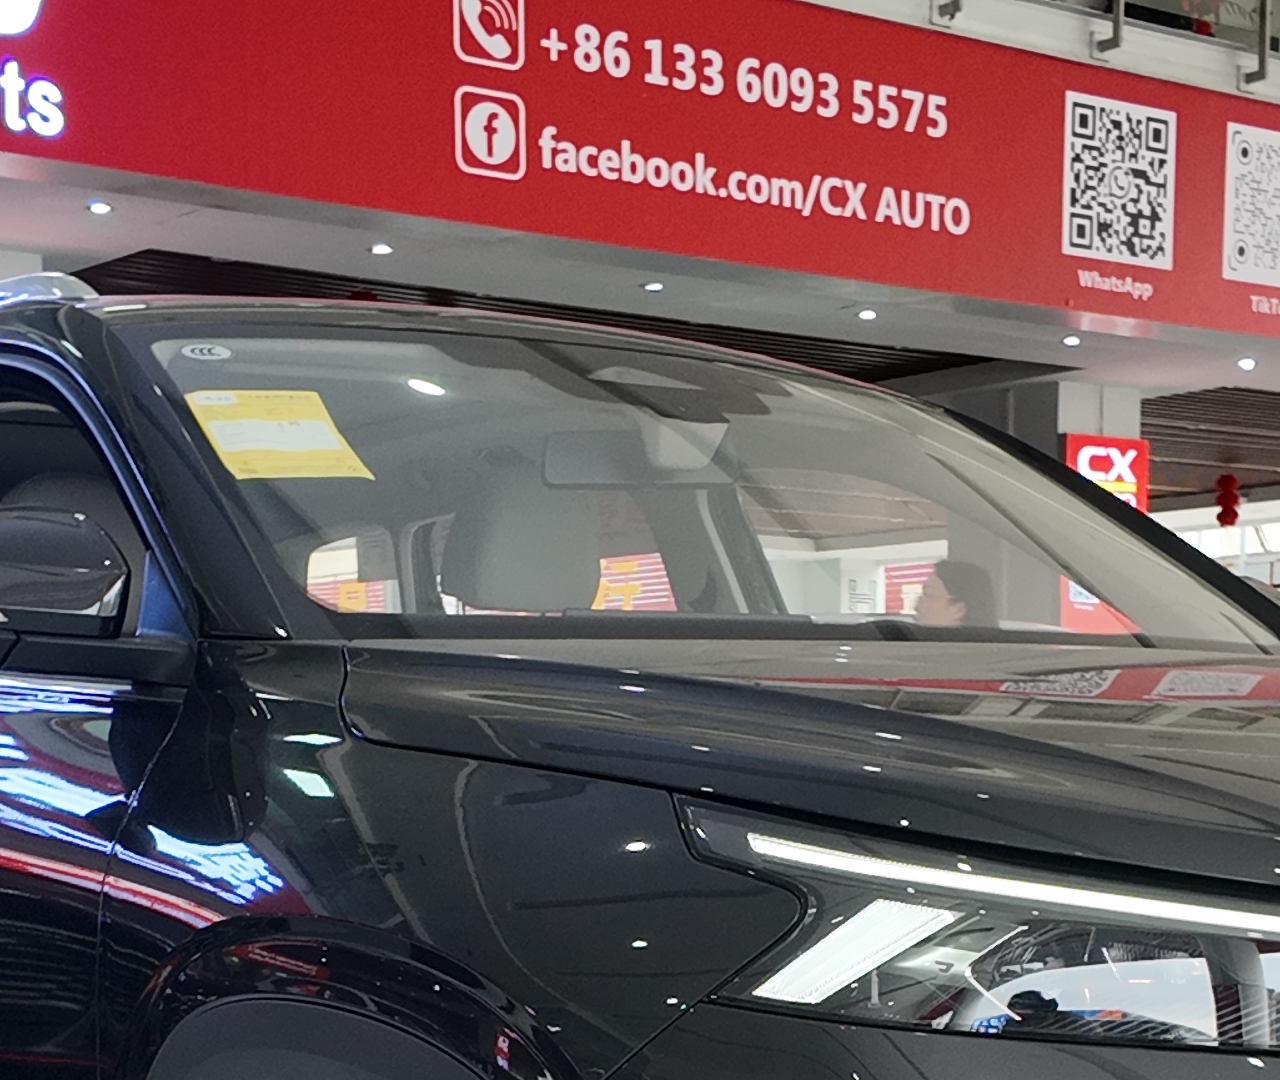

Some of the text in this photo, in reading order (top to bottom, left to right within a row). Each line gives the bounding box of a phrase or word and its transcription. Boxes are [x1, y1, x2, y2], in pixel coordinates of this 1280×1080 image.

[539, 23, 949, 139] +86 133 6093 5575
[538, 125, 971, 236] facebook.com/CX AUTO
[1076, 268, 1154, 302] WhatsApp
[1077, 445, 1138, 484] CX
